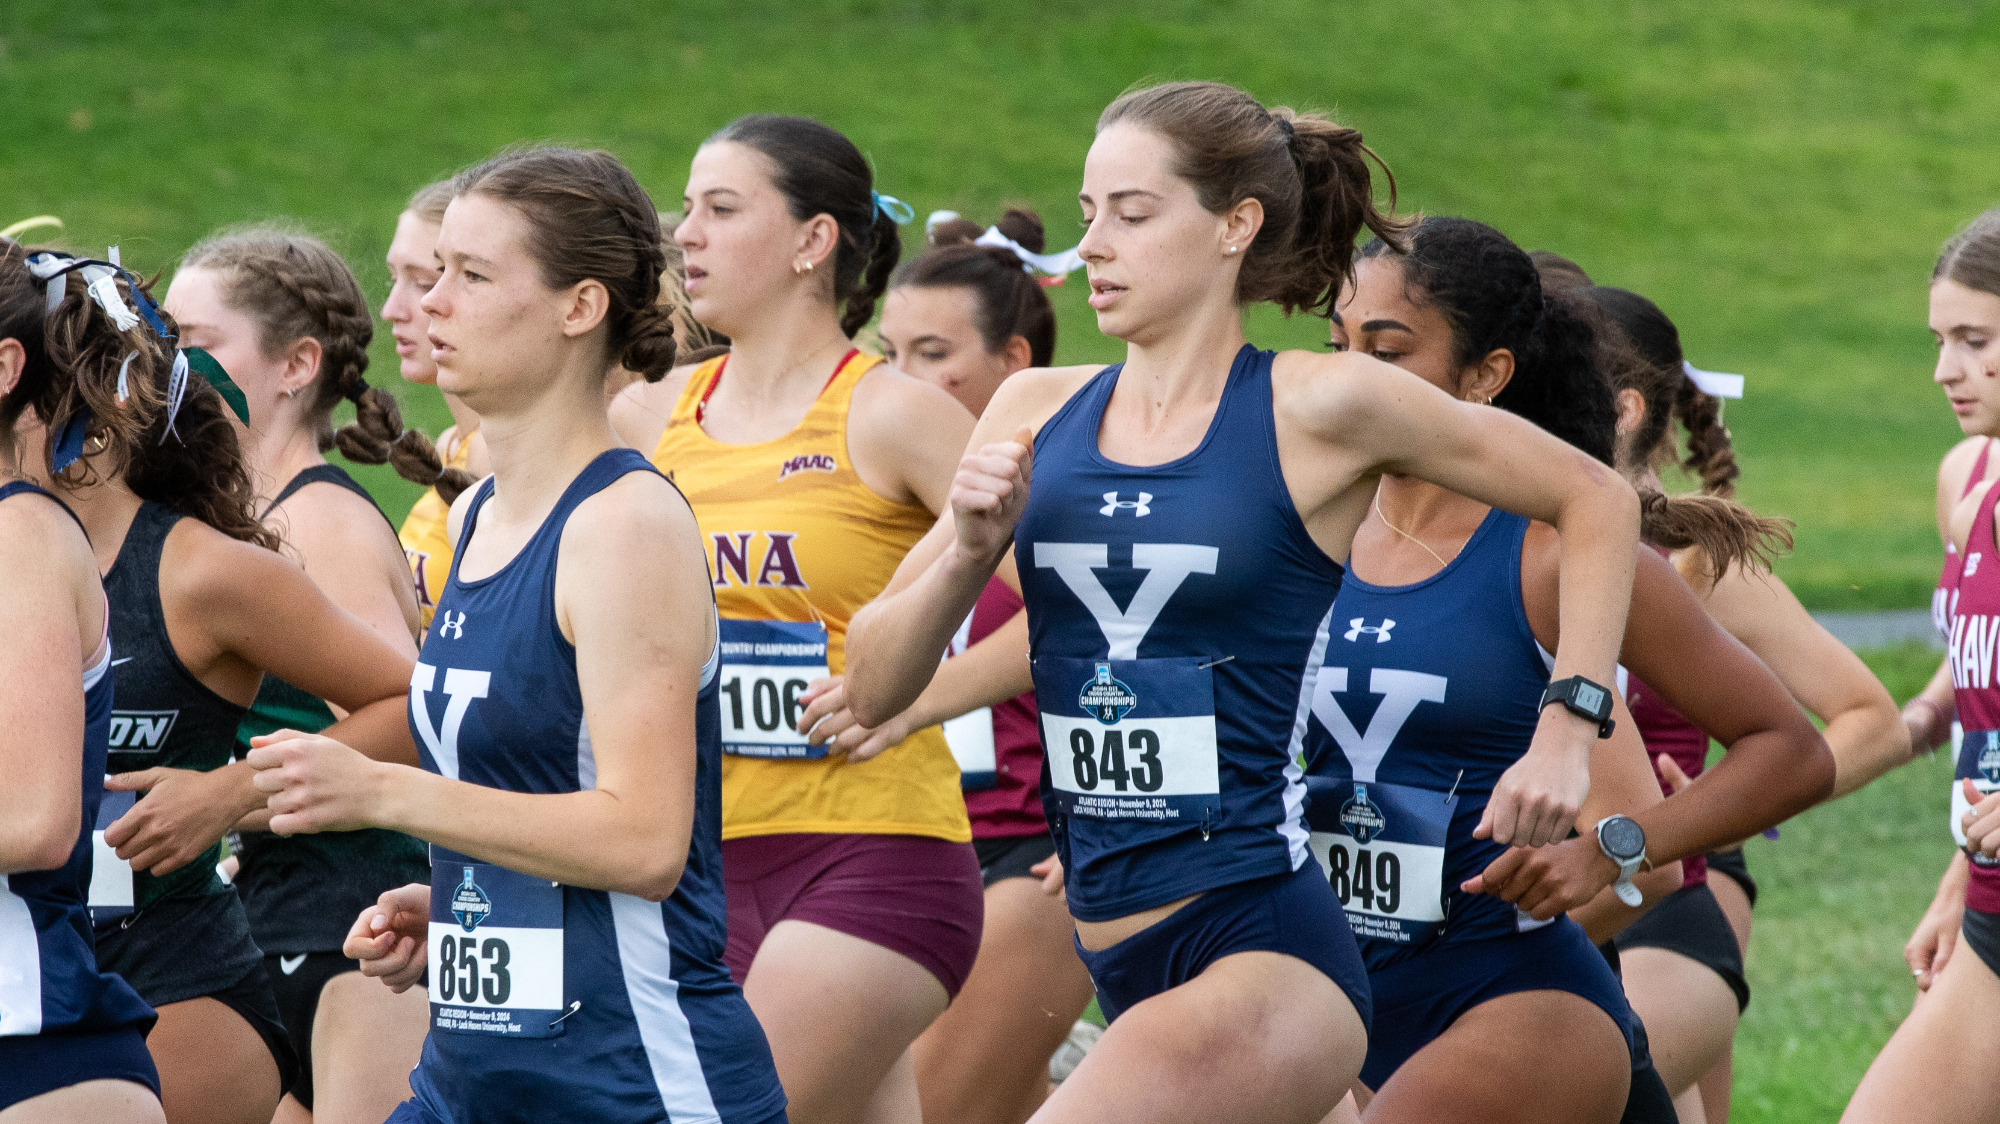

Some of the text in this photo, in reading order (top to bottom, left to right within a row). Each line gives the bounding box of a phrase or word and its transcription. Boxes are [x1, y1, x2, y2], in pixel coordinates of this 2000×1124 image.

[777, 454, 837, 483] MAAC
[1034, 542, 1220, 661] Y
[1949, 614, 2000, 690] HAV
[1080, 695, 1135, 706] CHAMPIONSHIPS
[1310, 666, 1448, 784] Y
[1069, 727, 1164, 793] 843
[1097, 798, 1116, 808] REGION
[1119, 798, 1146, 808] November
[1152, 798, 1167, 808] 2024
[452, 901, 490, 913] CHAMPIONSHIPS
[1328, 843, 1401, 914] 849
[439, 934, 511, 1005] 853
